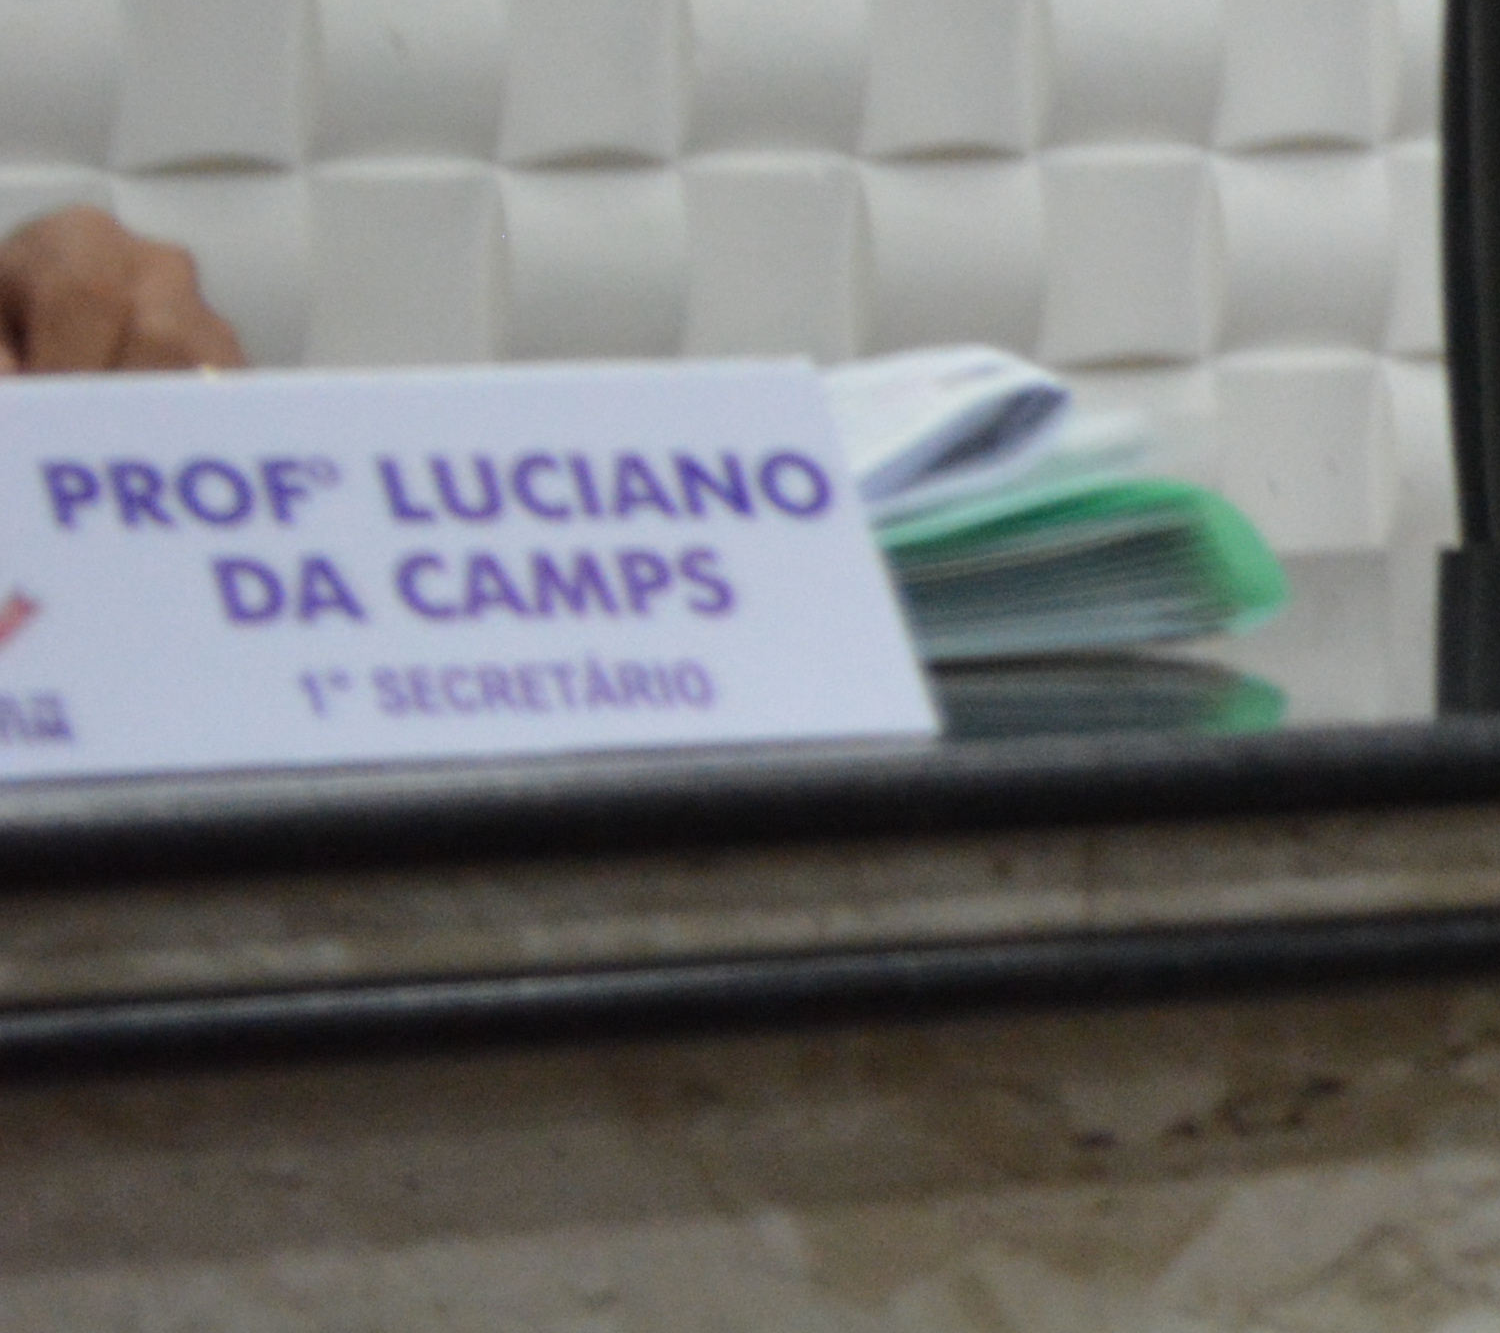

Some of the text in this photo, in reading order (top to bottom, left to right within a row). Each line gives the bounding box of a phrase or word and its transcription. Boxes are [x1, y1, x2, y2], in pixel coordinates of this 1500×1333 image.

[375, 450, 833, 524] LUCIANO
[211, 546, 736, 624] DA CAMPS
[371, 654, 716, 718] SECRETÁRIO
